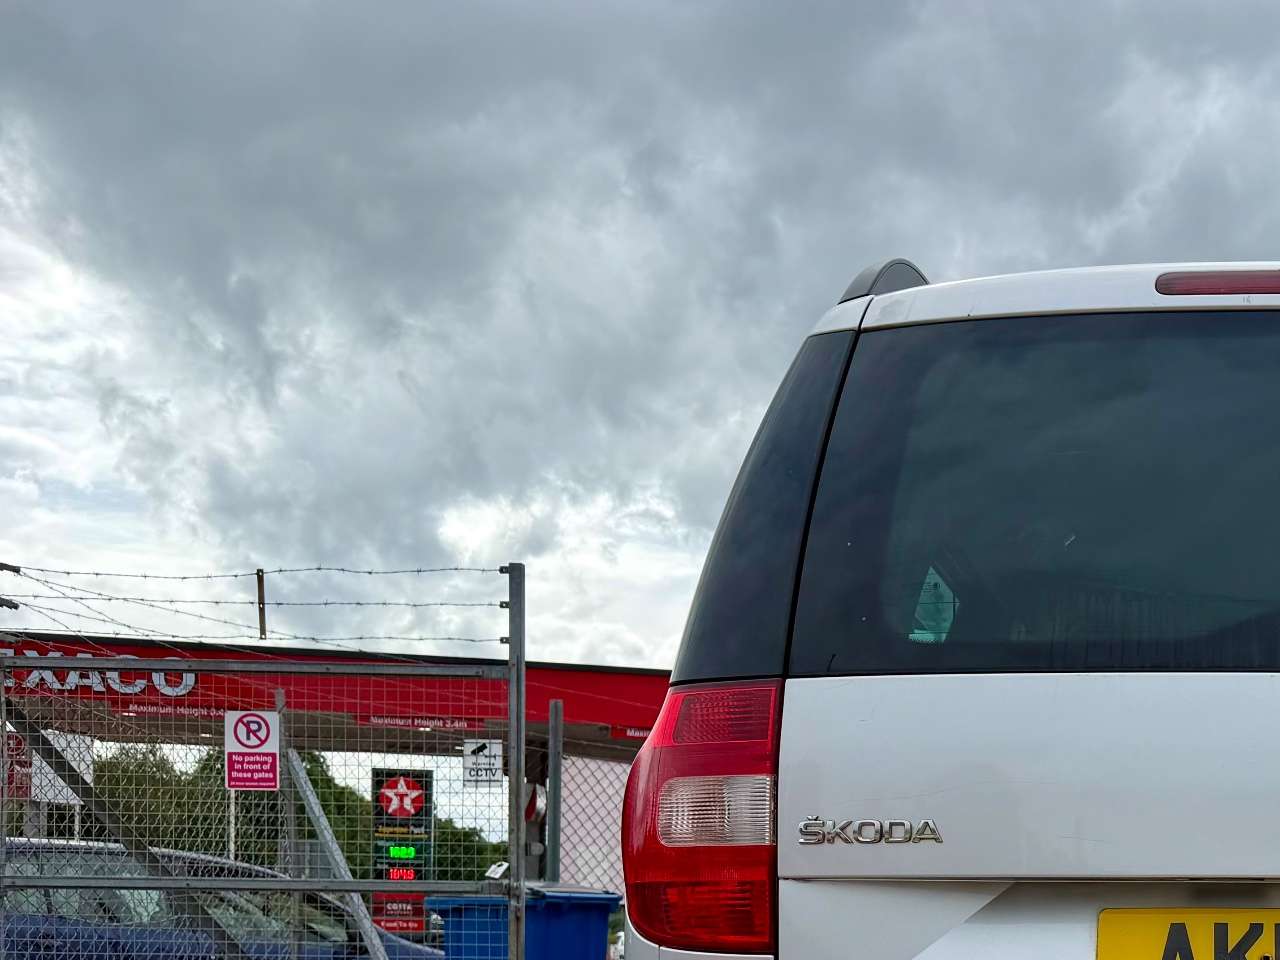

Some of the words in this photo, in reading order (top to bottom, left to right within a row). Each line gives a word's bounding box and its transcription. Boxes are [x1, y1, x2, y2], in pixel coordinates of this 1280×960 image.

[176, 706, 207, 716] Height
[414, 718, 443, 728] Height
[244, 754, 272, 763] parking
[253, 772, 274, 780] gates
[469, 768, 498, 778] CCTV
[798, 815, 944, 845] ŠKODA
